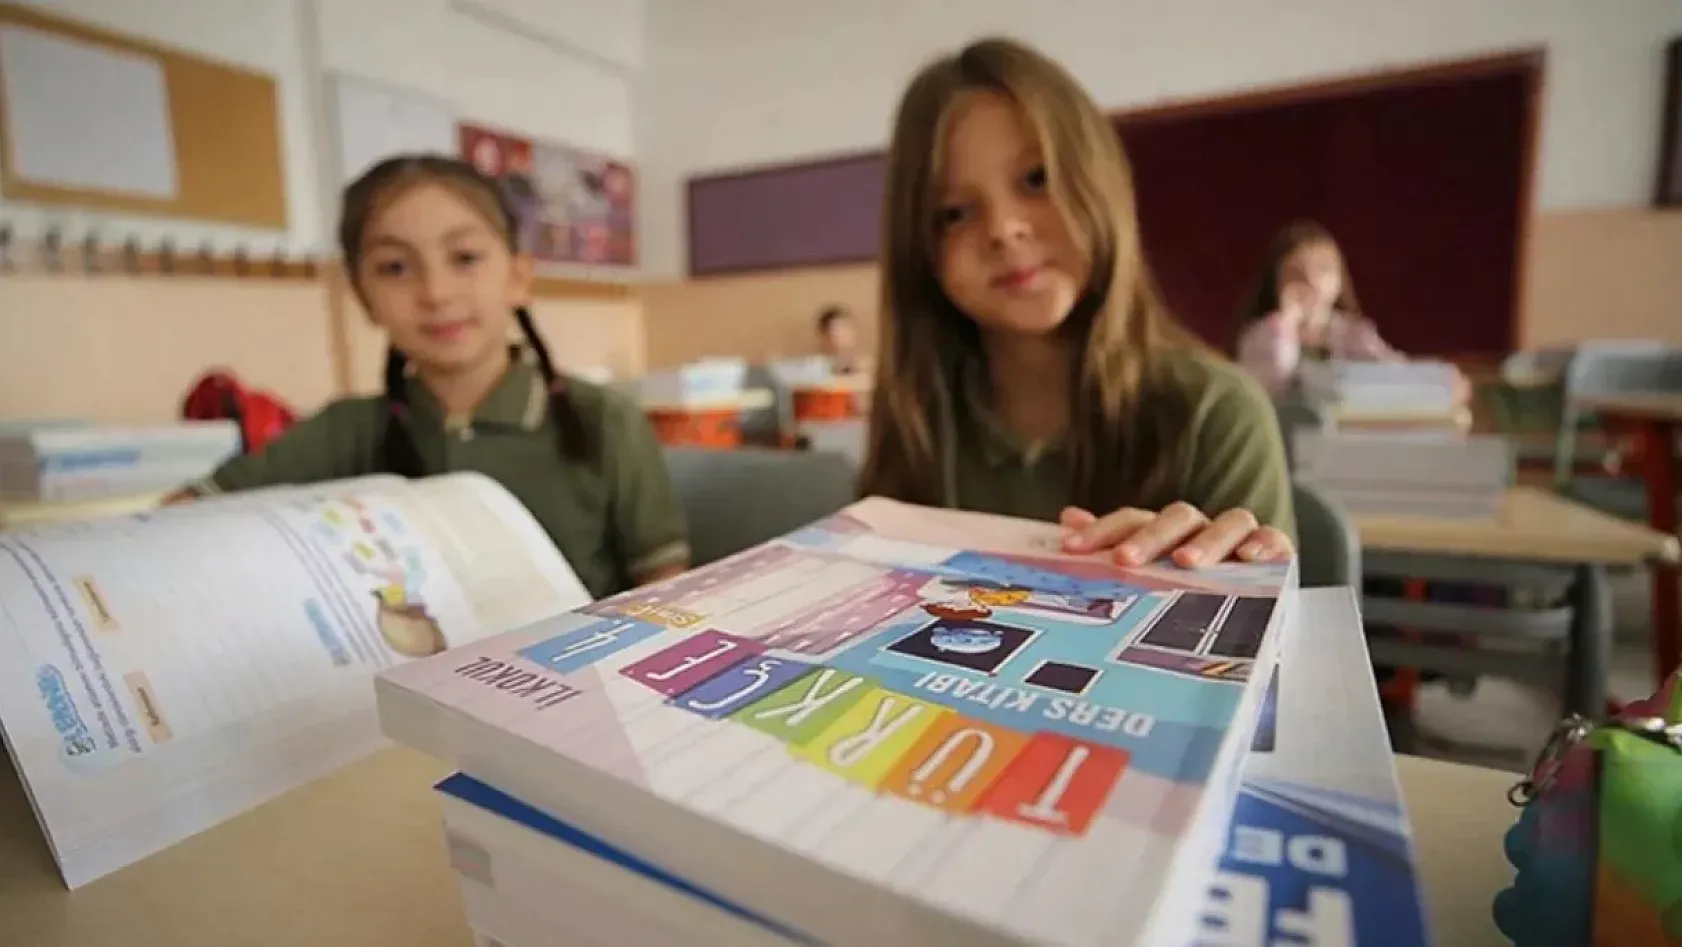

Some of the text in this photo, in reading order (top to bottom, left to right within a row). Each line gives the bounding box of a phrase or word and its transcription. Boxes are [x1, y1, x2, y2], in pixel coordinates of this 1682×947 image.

[454, 656, 583, 711] İLKOKUL
[913, 671, 1157, 738] DERS KİTABI
[647, 638, 1089, 825] TÜRKÇE
